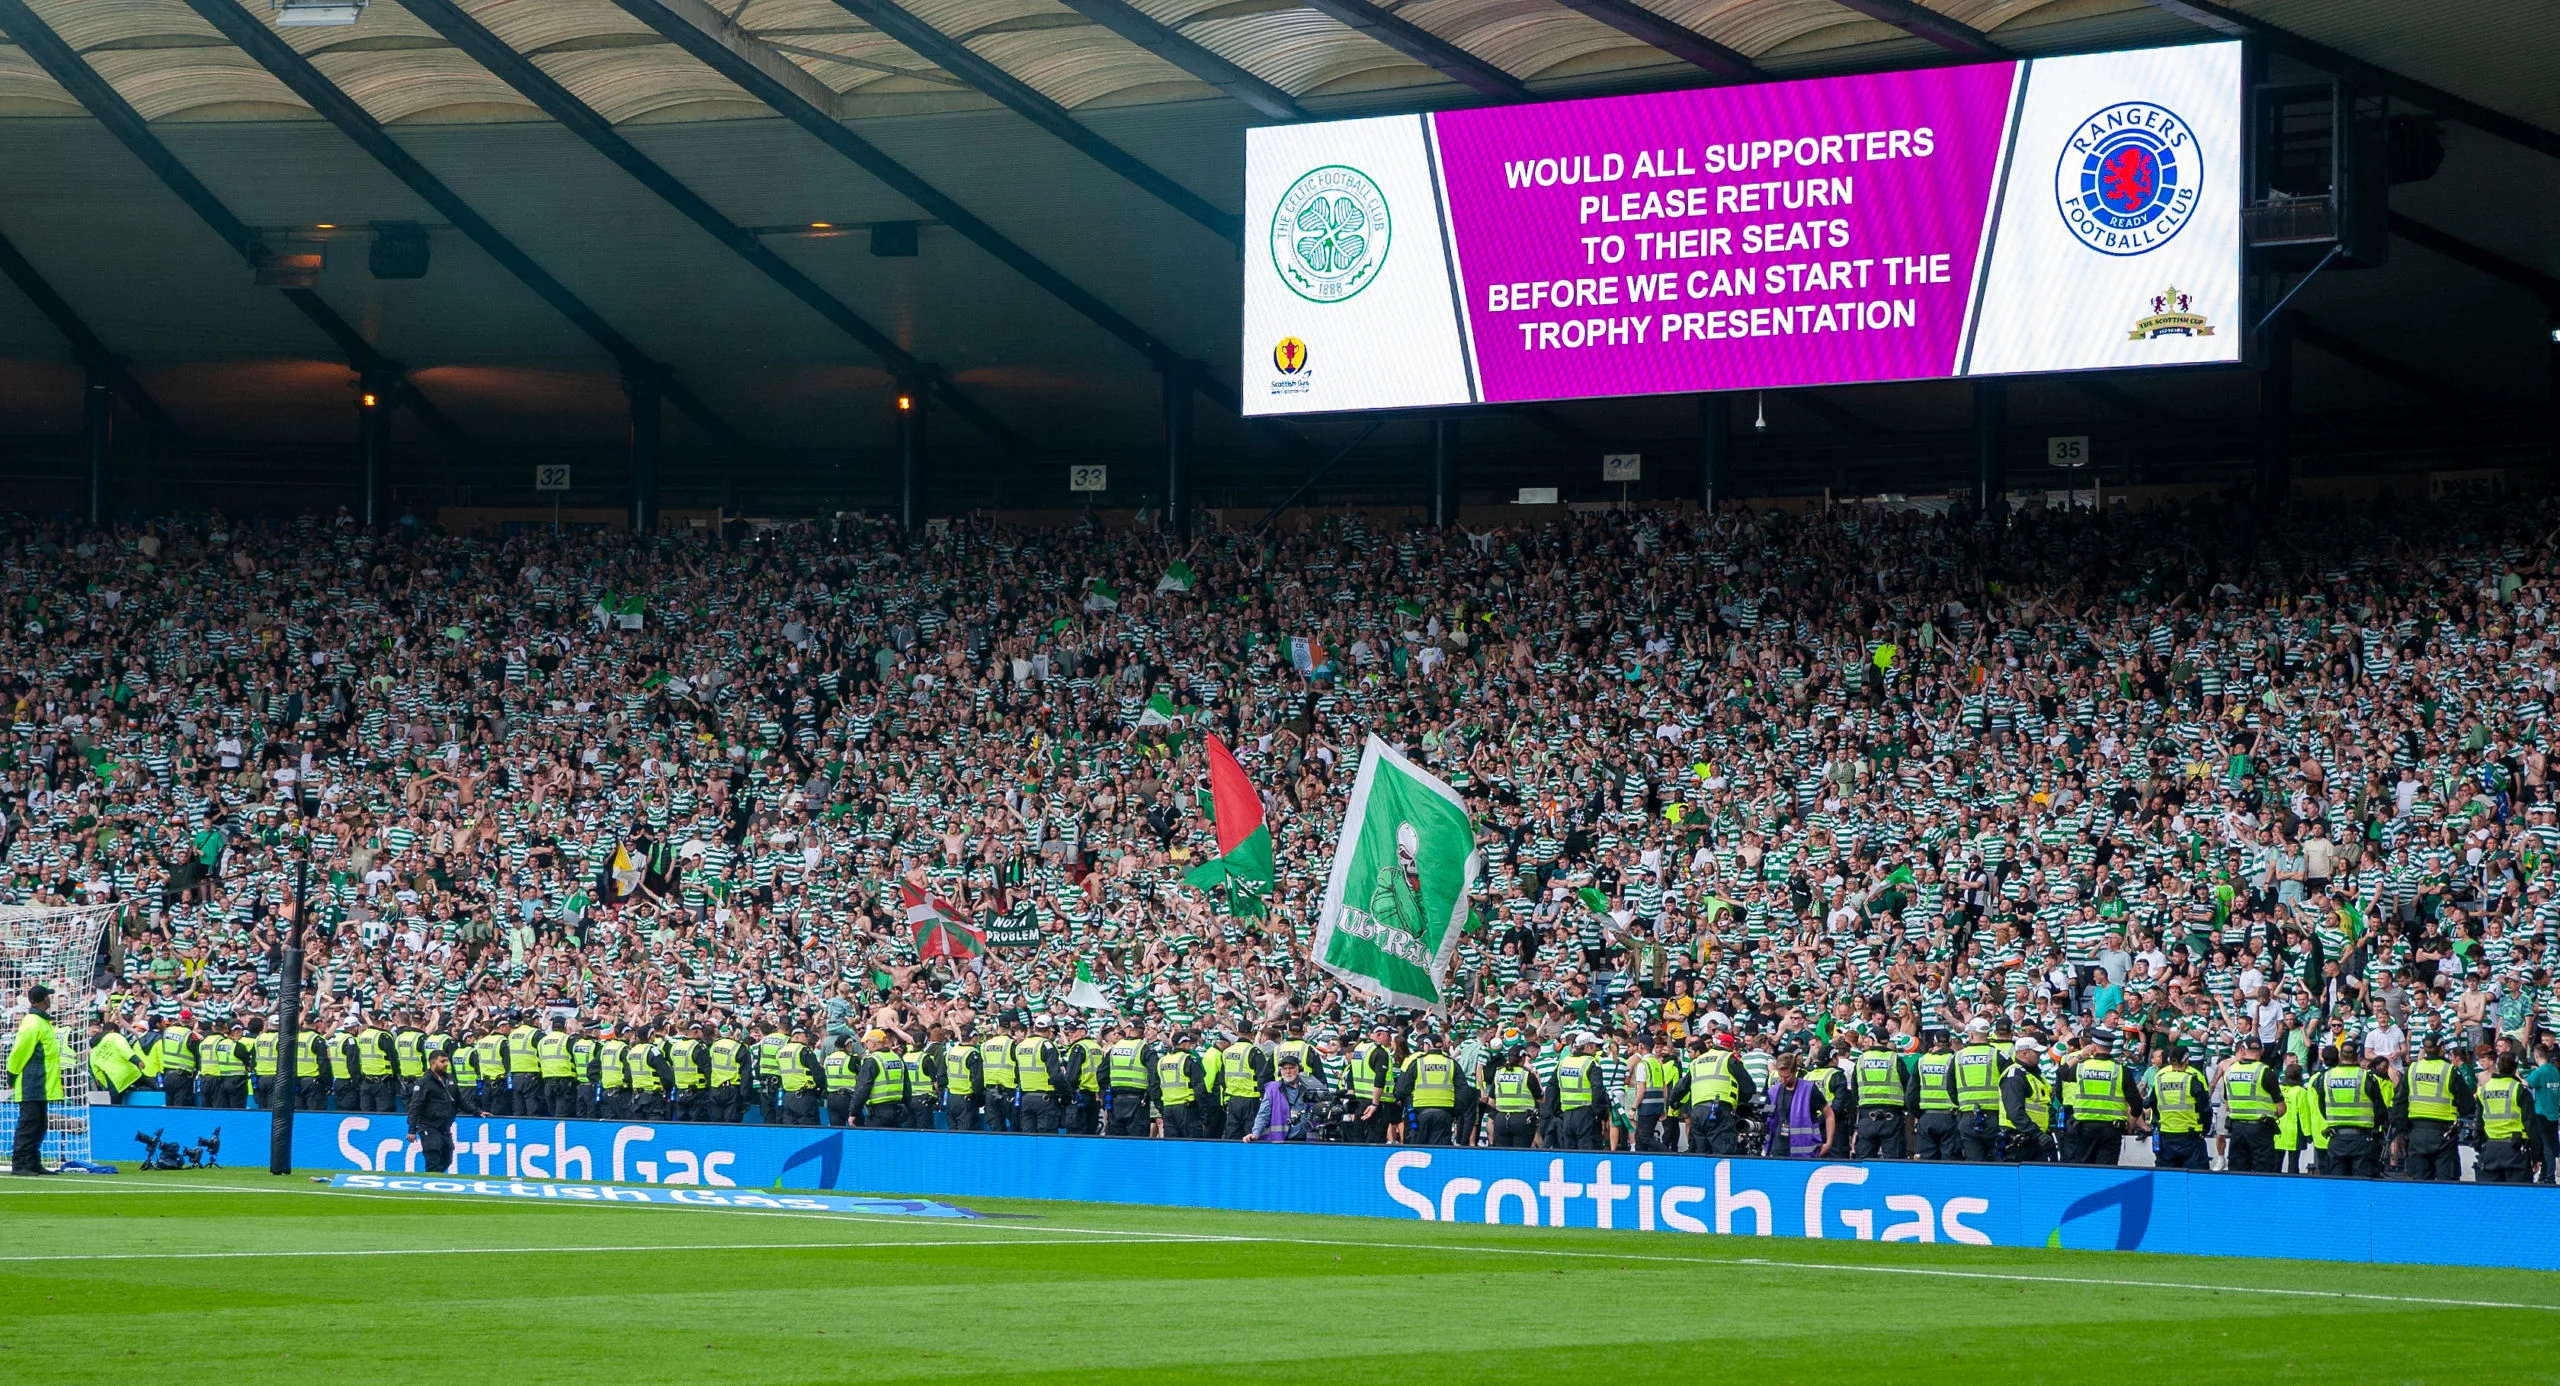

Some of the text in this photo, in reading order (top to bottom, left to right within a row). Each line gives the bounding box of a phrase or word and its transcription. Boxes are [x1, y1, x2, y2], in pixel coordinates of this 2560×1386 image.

[2073, 108, 2187, 154] RANGERS
[1504, 127, 1935, 189] WOULD ALL SUPPORTERS
[1277, 172, 1385, 239] THE CELTIC FOOTBALL CLUB
[1580, 176, 1853, 224] PLEASE RETURN
[2065, 188, 2193, 249] FOOTBALL CLUB
[2110, 213, 2149, 228] READY
[1581, 218, 1850, 265] TO THEIR SEATS
[1488, 253, 1951, 312] BEFORE WE CAN START THE
[1518, 298, 1916, 350] TROPHY PRESENTATION
[2056, 441, 2081, 459] 35
[540, 468, 566, 486] 32
[993, 915, 1028, 928] NOT A
[986, 928, 1040, 943] PROBLEM
[1336, 903, 1434, 976] ULTRAS
[1864, 1060, 1888, 1068] POLICE
[1962, 1055, 1988, 1064] POLICE
[1499, 1073, 1521, 1082] POLICE
[1560, 1068, 1580, 1077] POLICE
[1922, 1065, 1945, 1073] POLICE
[2229, 1072, 2254, 1081] POLICE
[2416, 1073, 2440, 1082] POLICE
[2161, 1082, 2183, 1090] POLICE
[2331, 1079, 2357, 1088] POLICE
[2484, 1090, 2510, 1099] POLICE
[338, 1116, 737, 1187] Scttish Gas
[343, 1173, 829, 1210] Scottish Gas
[1384, 1150, 1993, 1246] Scottish Gas
